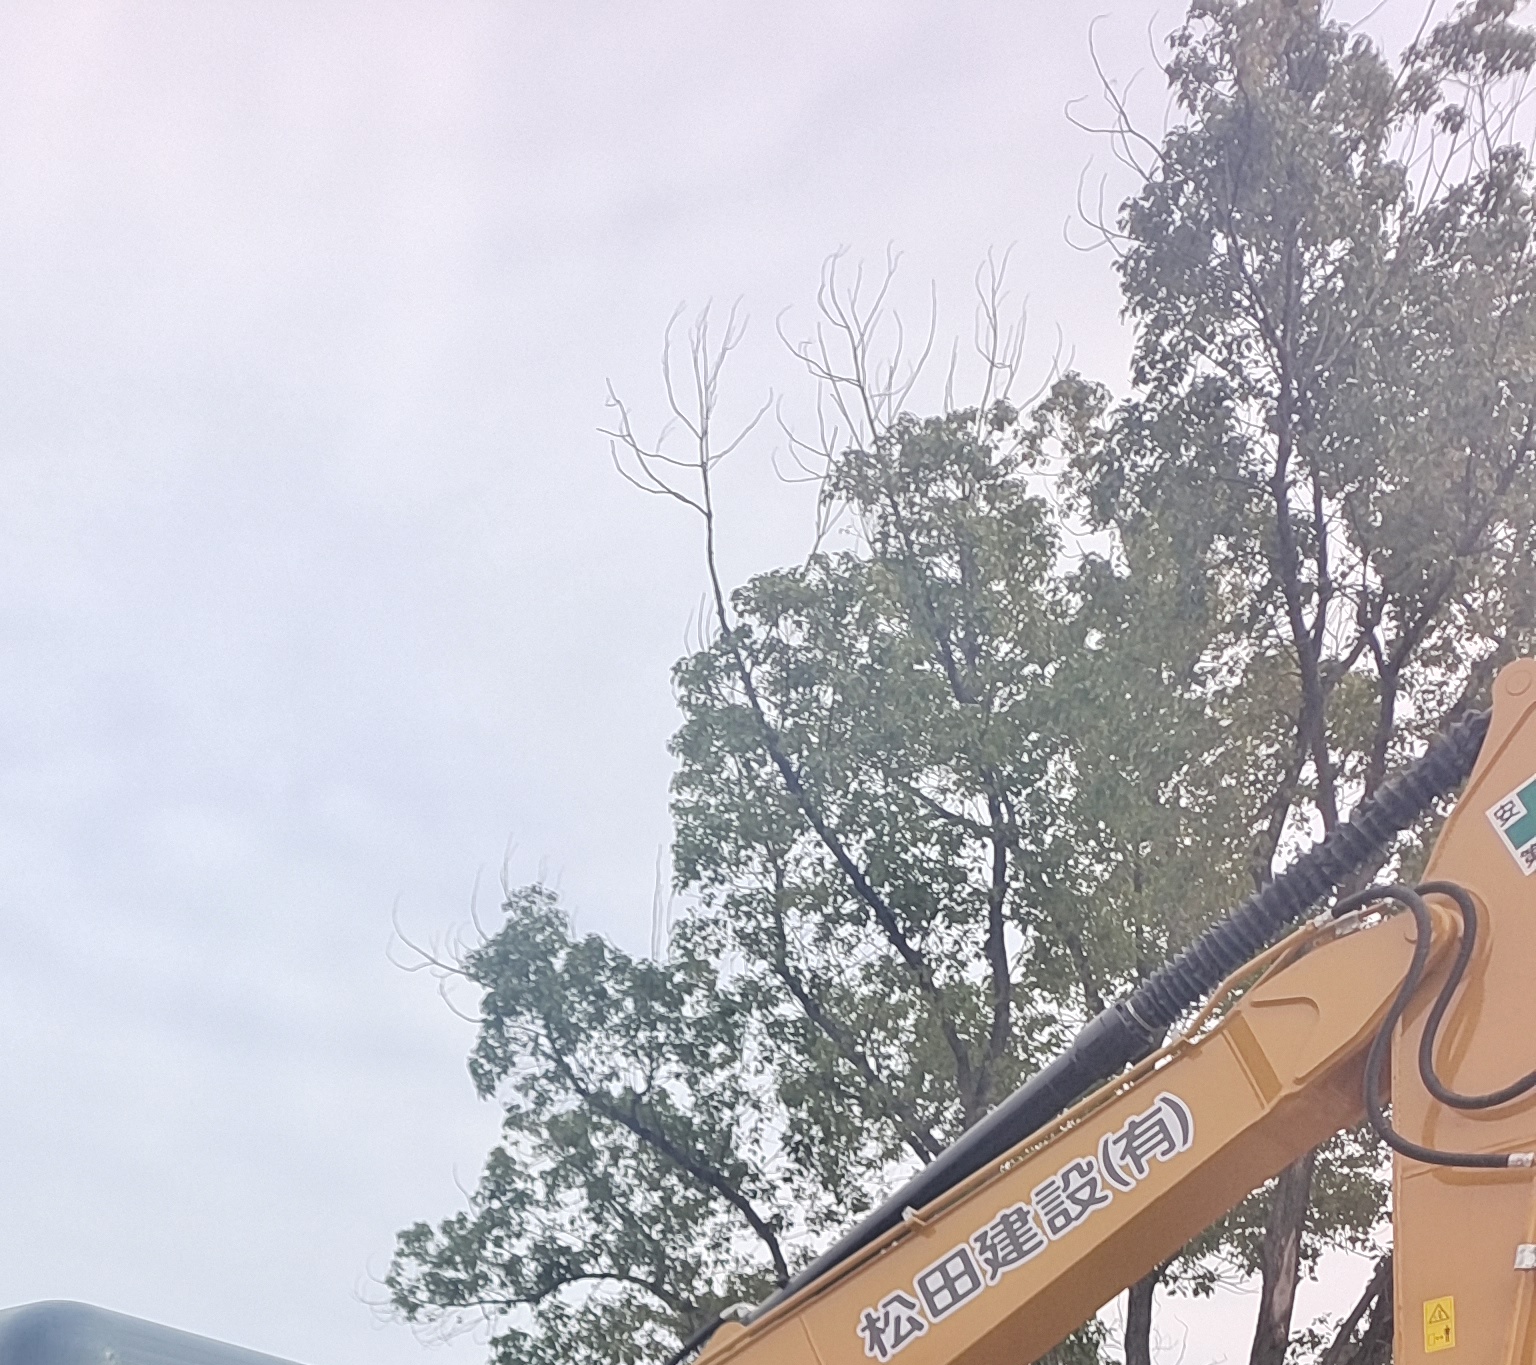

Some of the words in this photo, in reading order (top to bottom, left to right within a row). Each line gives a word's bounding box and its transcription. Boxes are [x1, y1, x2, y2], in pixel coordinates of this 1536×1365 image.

[858, 1093, 1194, 1361] 松田建設(有)
